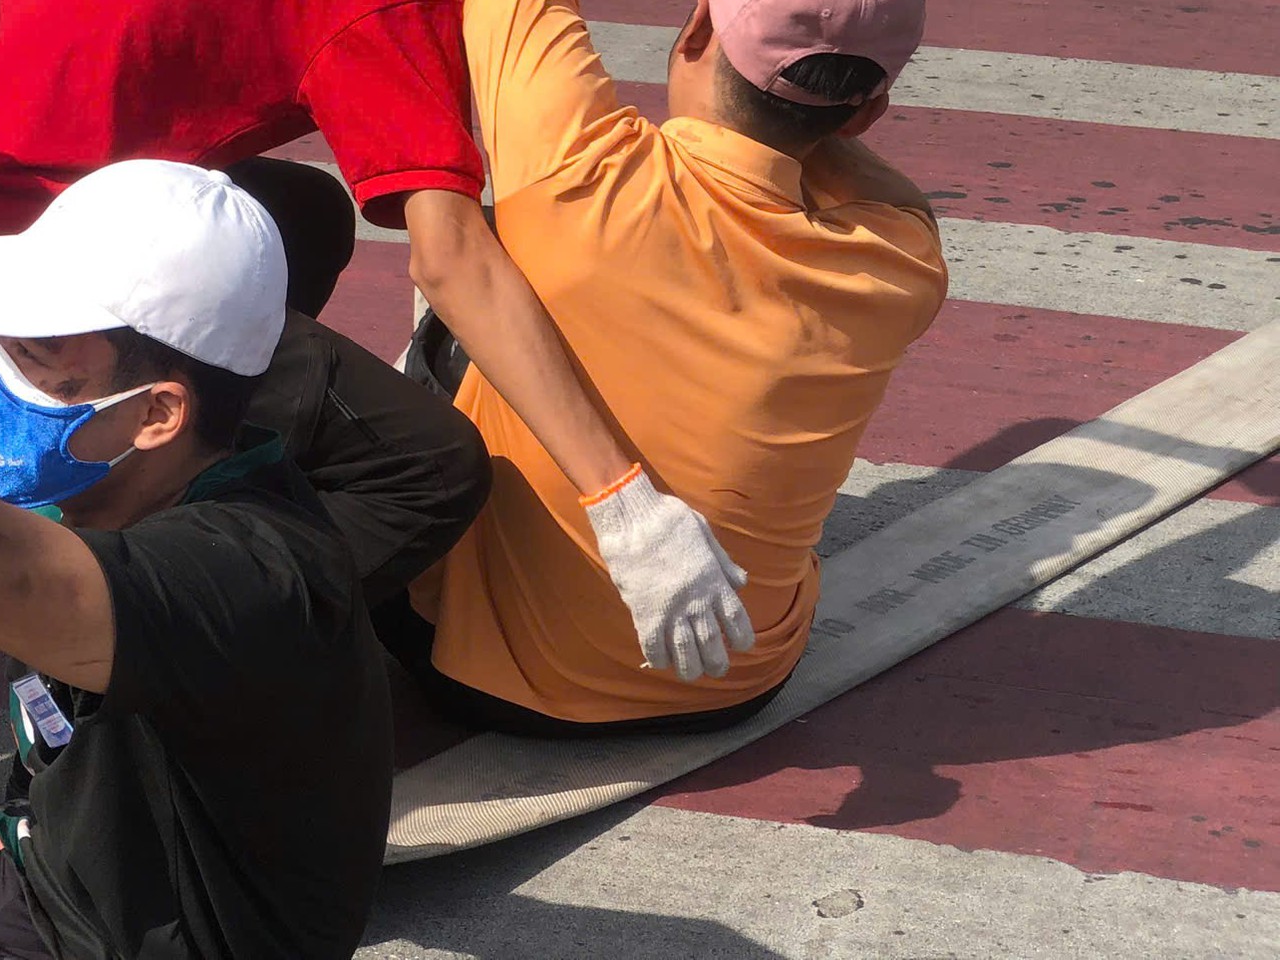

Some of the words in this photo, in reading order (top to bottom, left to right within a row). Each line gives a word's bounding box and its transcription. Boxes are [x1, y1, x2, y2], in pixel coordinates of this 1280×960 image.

[908, 550, 977, 584] MADE
[960, 532, 1009, 553] IN
[991, 494, 1082, 536] GERMANY
